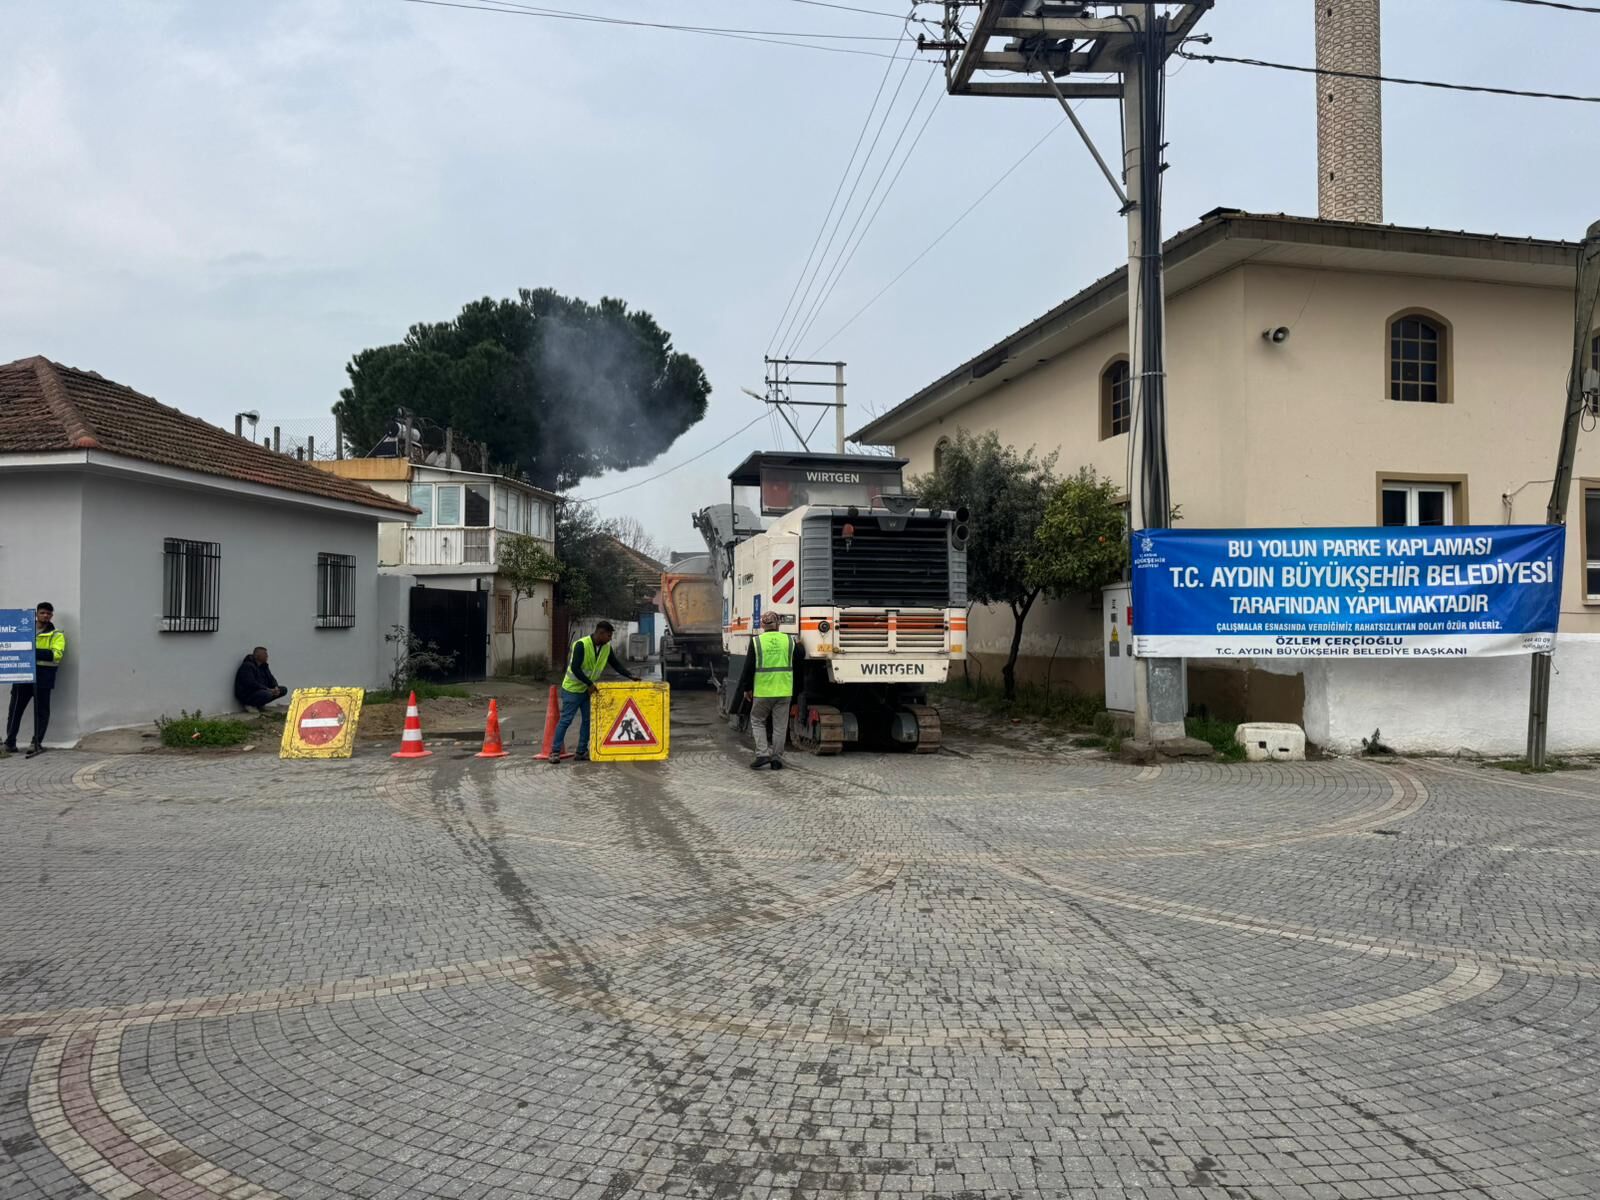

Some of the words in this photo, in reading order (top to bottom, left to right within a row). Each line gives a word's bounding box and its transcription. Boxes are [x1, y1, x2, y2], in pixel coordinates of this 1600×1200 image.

[806, 471, 860, 484] WIRTGEN
[1228, 540, 1253, 558] BU
[1258, 539, 1317, 557] YOLUN
[1323, 538, 1381, 557] PARKE
[1387, 537, 1493, 556] KAPLAMASI
[1169, 566, 1204, 588] T.C.
[1210, 566, 1274, 588] AYDIN
[1282, 561, 1420, 593] BÜYÜKŞEHİR
[1426, 556, 1553, 587] BELEDİYESİ
[1229, 596, 1340, 615] TARAFINDAN
[1344, 594, 1489, 615] YAPILMAKTADIR
[1216, 622, 1263, 633] ÇALIŞMALAR
[1264, 622, 1306, 632] ESNASINDA
[1308, 621, 1353, 632] VERDİĞİMİZ
[1354, 622, 1416, 632] RAHATSIZLIKTAN
[1418, 621, 1445, 631] DOLAYI
[1446, 620, 1467, 630] ÖZÜR
[1469, 619, 1503, 630] DİLERİZ.
[1275, 635, 1321, 646] ÖZLEM
[1324, 635, 1403, 647] ÇERÇİOĞLU
[1216, 648, 1235, 656] T.C.
[1238, 648, 1273, 656] AYDIN
[1276, 646, 1350, 657] BÜYÜKŞEHİR
[1352, 646, 1410, 656] BELEDİYE
[1413, 647, 1468, 657] BAŞKANI
[860, 663, 925, 676] WIRTGEN
